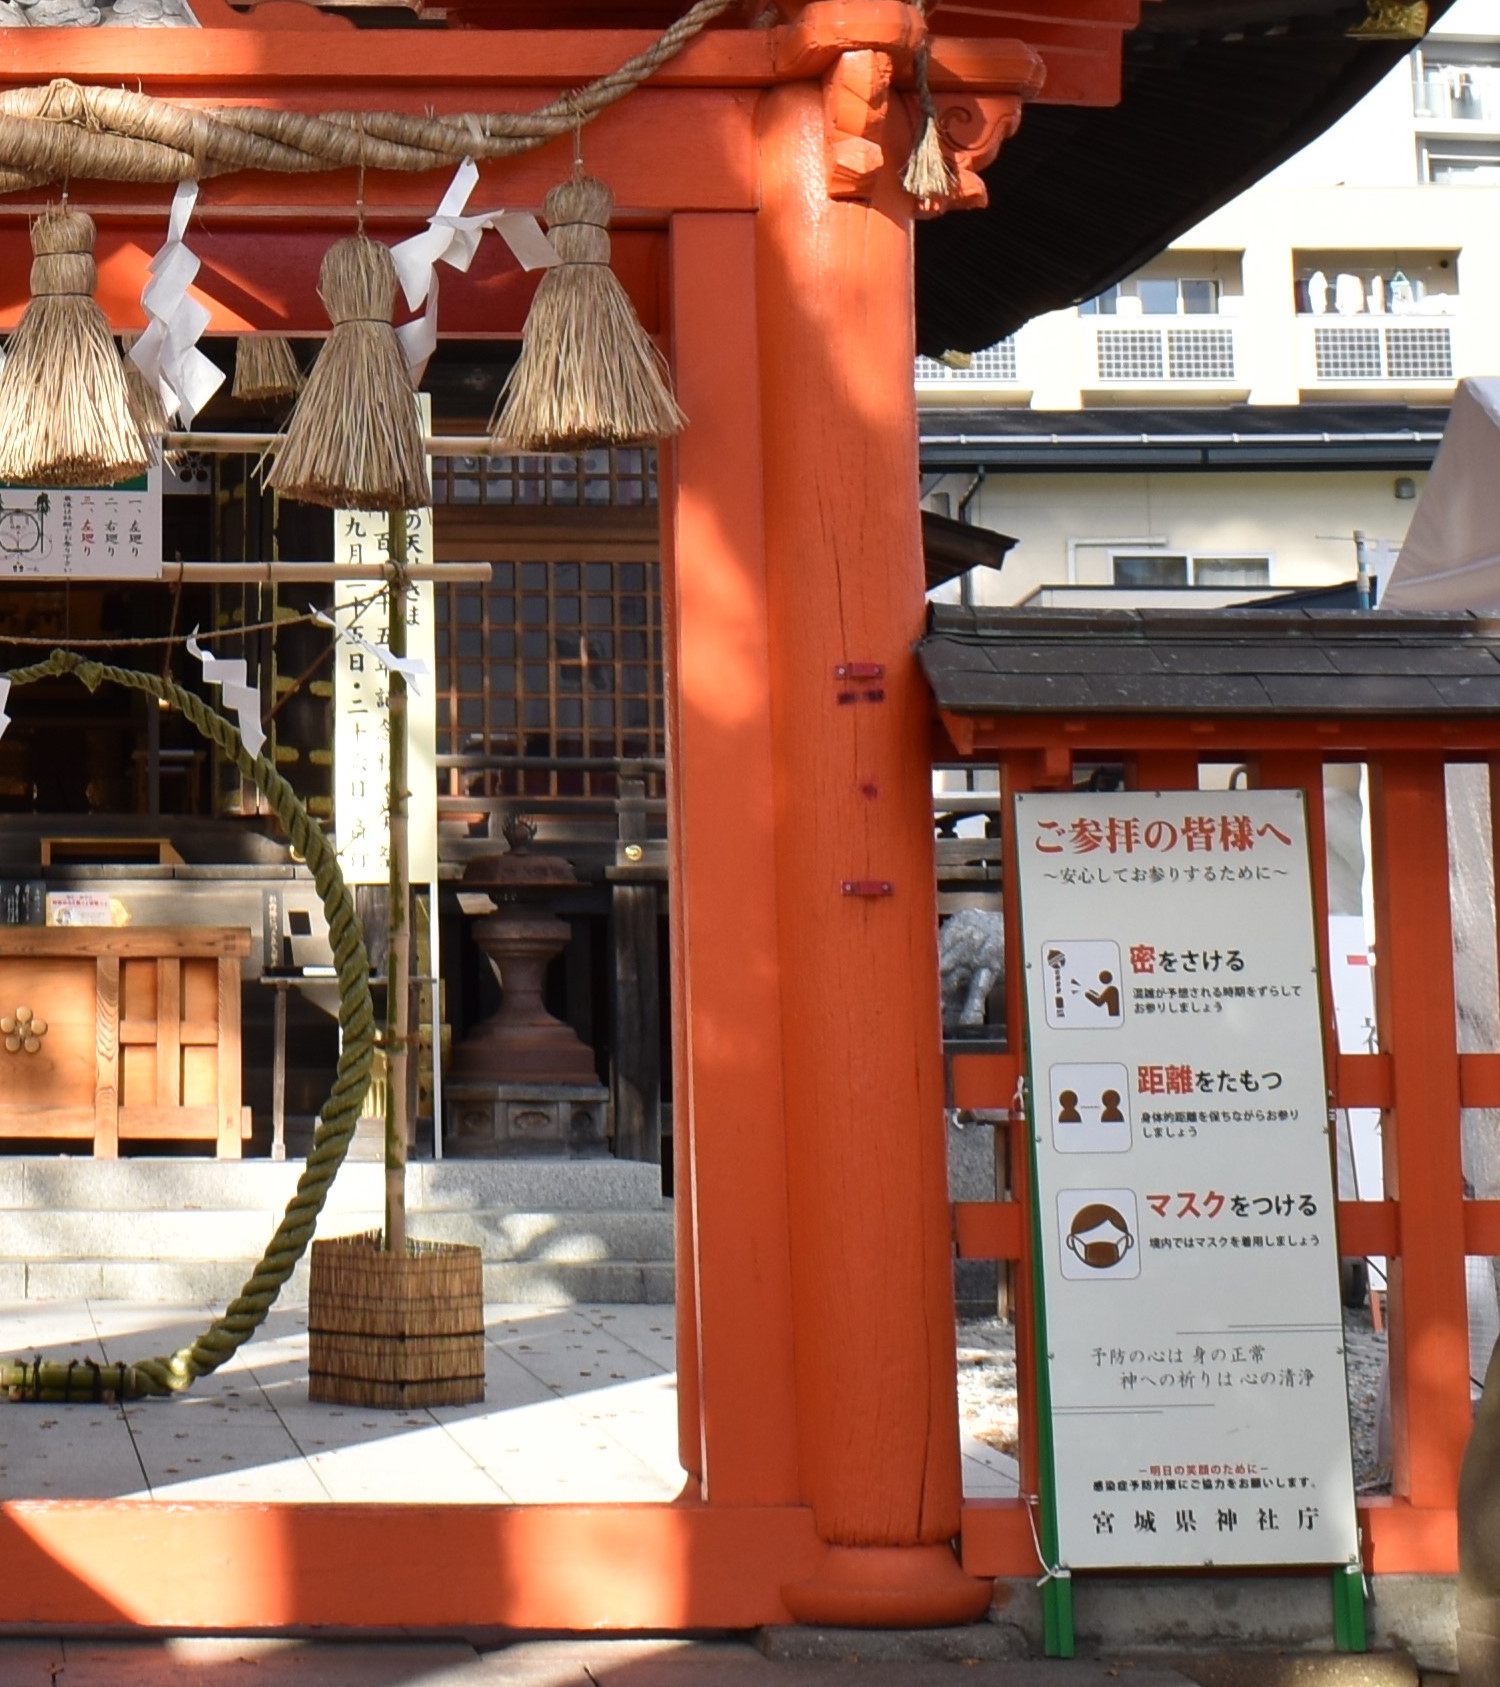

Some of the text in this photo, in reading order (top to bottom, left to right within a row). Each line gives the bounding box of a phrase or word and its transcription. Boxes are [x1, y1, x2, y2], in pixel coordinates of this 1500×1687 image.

[1034, 815, 1292, 855] ご参拝の皆様へ
[1129, 944, 1245, 975] 密をさける
[1134, 1001, 1223, 1015] お参りしましょう
[1137, 1064, 1283, 1096] 距離をたもつ
[1143, 1125, 1198, 1139] しましょう
[1145, 1190, 1318, 1220] マスクをつける
[1149, 1234, 1321, 1249] 境内ではマスクを着用しましょう
[1092, 1506, 1321, 1535] 宮城県神社庁
